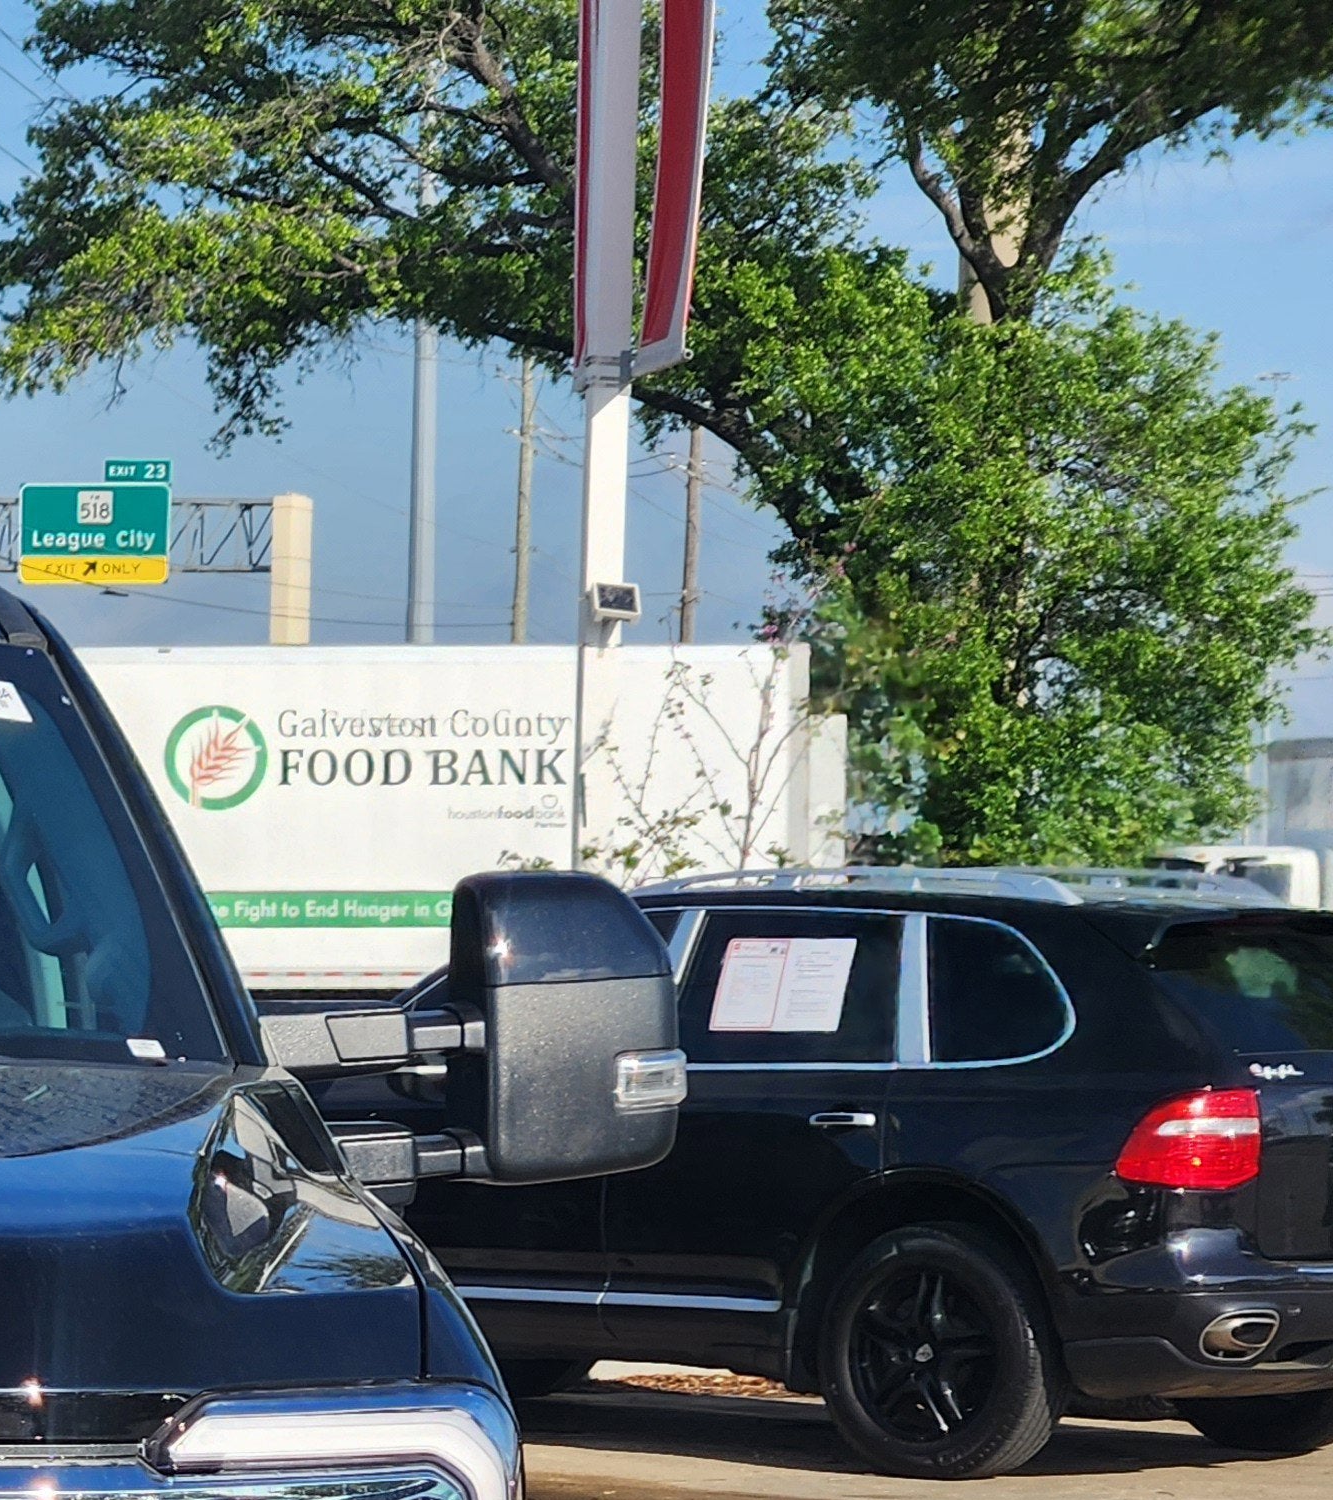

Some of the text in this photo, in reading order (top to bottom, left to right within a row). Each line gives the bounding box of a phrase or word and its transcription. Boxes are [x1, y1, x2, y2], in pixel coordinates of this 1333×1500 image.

[108, 463, 167, 479] EXIT 23
[80, 502, 110, 519] 518
[32, 529, 156, 552] League City
[44, 562, 142, 575] EXIT ONLY
[277, 708, 571, 744] Galveston County
[277, 748, 568, 787] FOOD BANK
[234, 899, 277, 922] Fight
[282, 901, 300, 918] to
[305, 899, 339, 918] End
[414, 900, 430, 917] in
